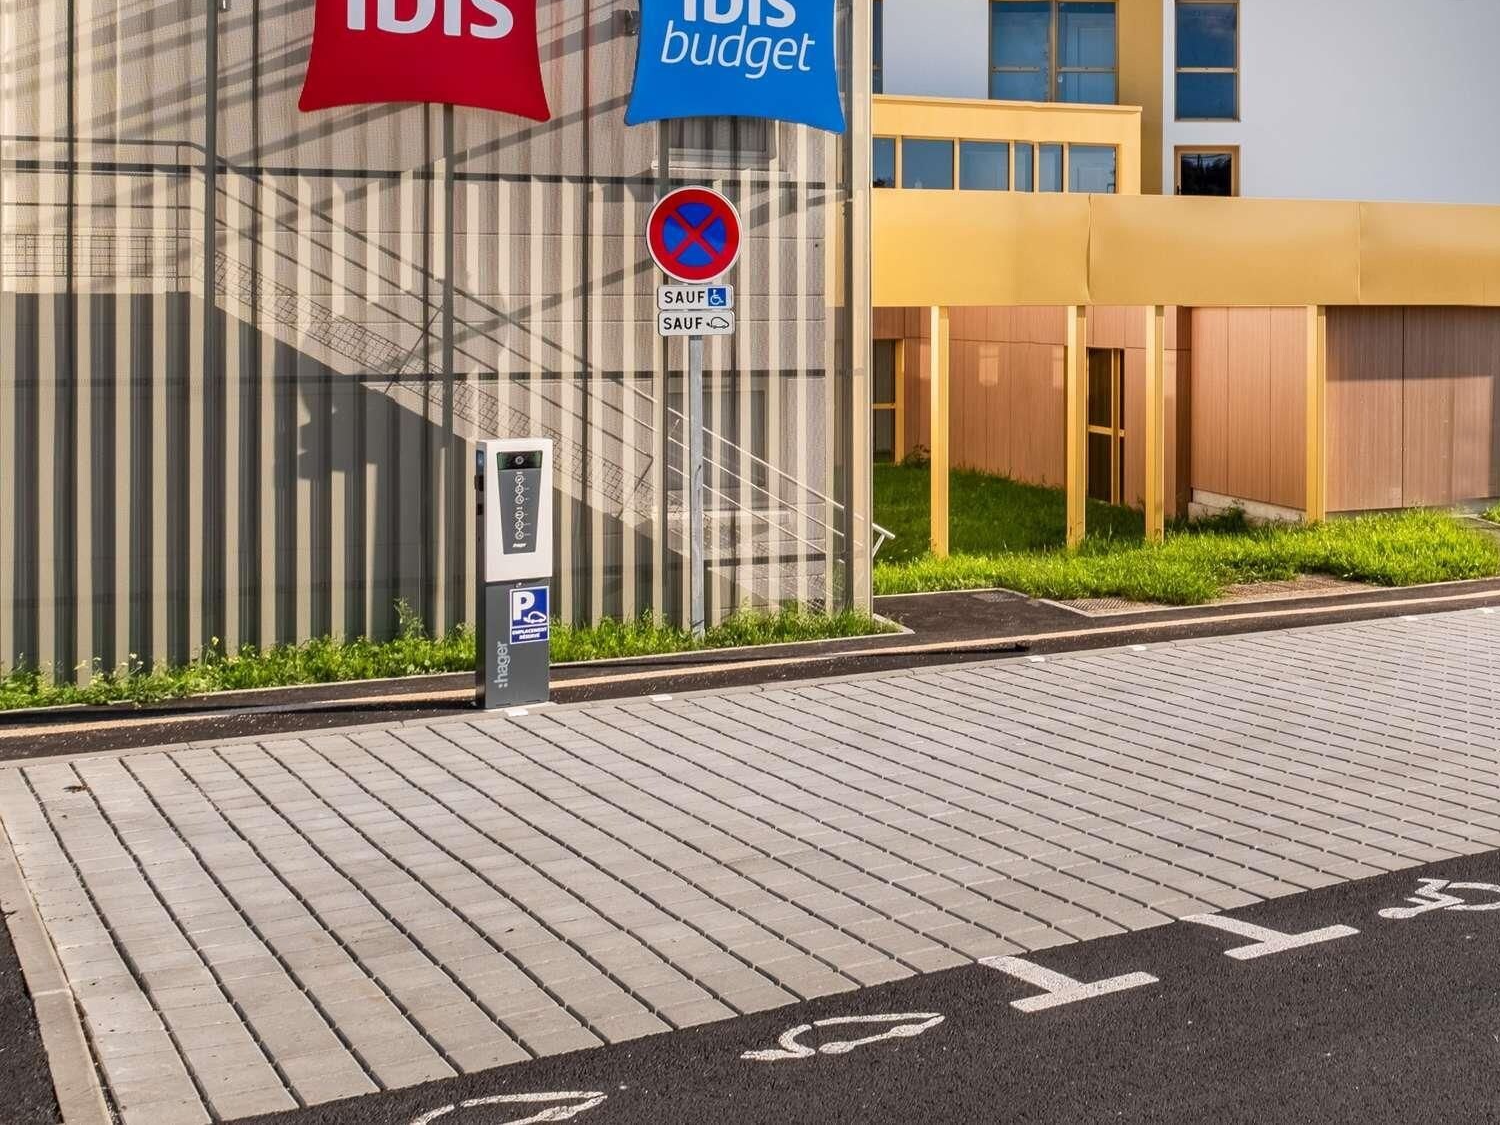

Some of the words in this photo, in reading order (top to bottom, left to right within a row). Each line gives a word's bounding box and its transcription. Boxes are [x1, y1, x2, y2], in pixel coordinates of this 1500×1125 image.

[661, 20, 815, 79] budget
[664, 291, 705, 303] SAUF
[663, 317, 704, 330] SAUF
